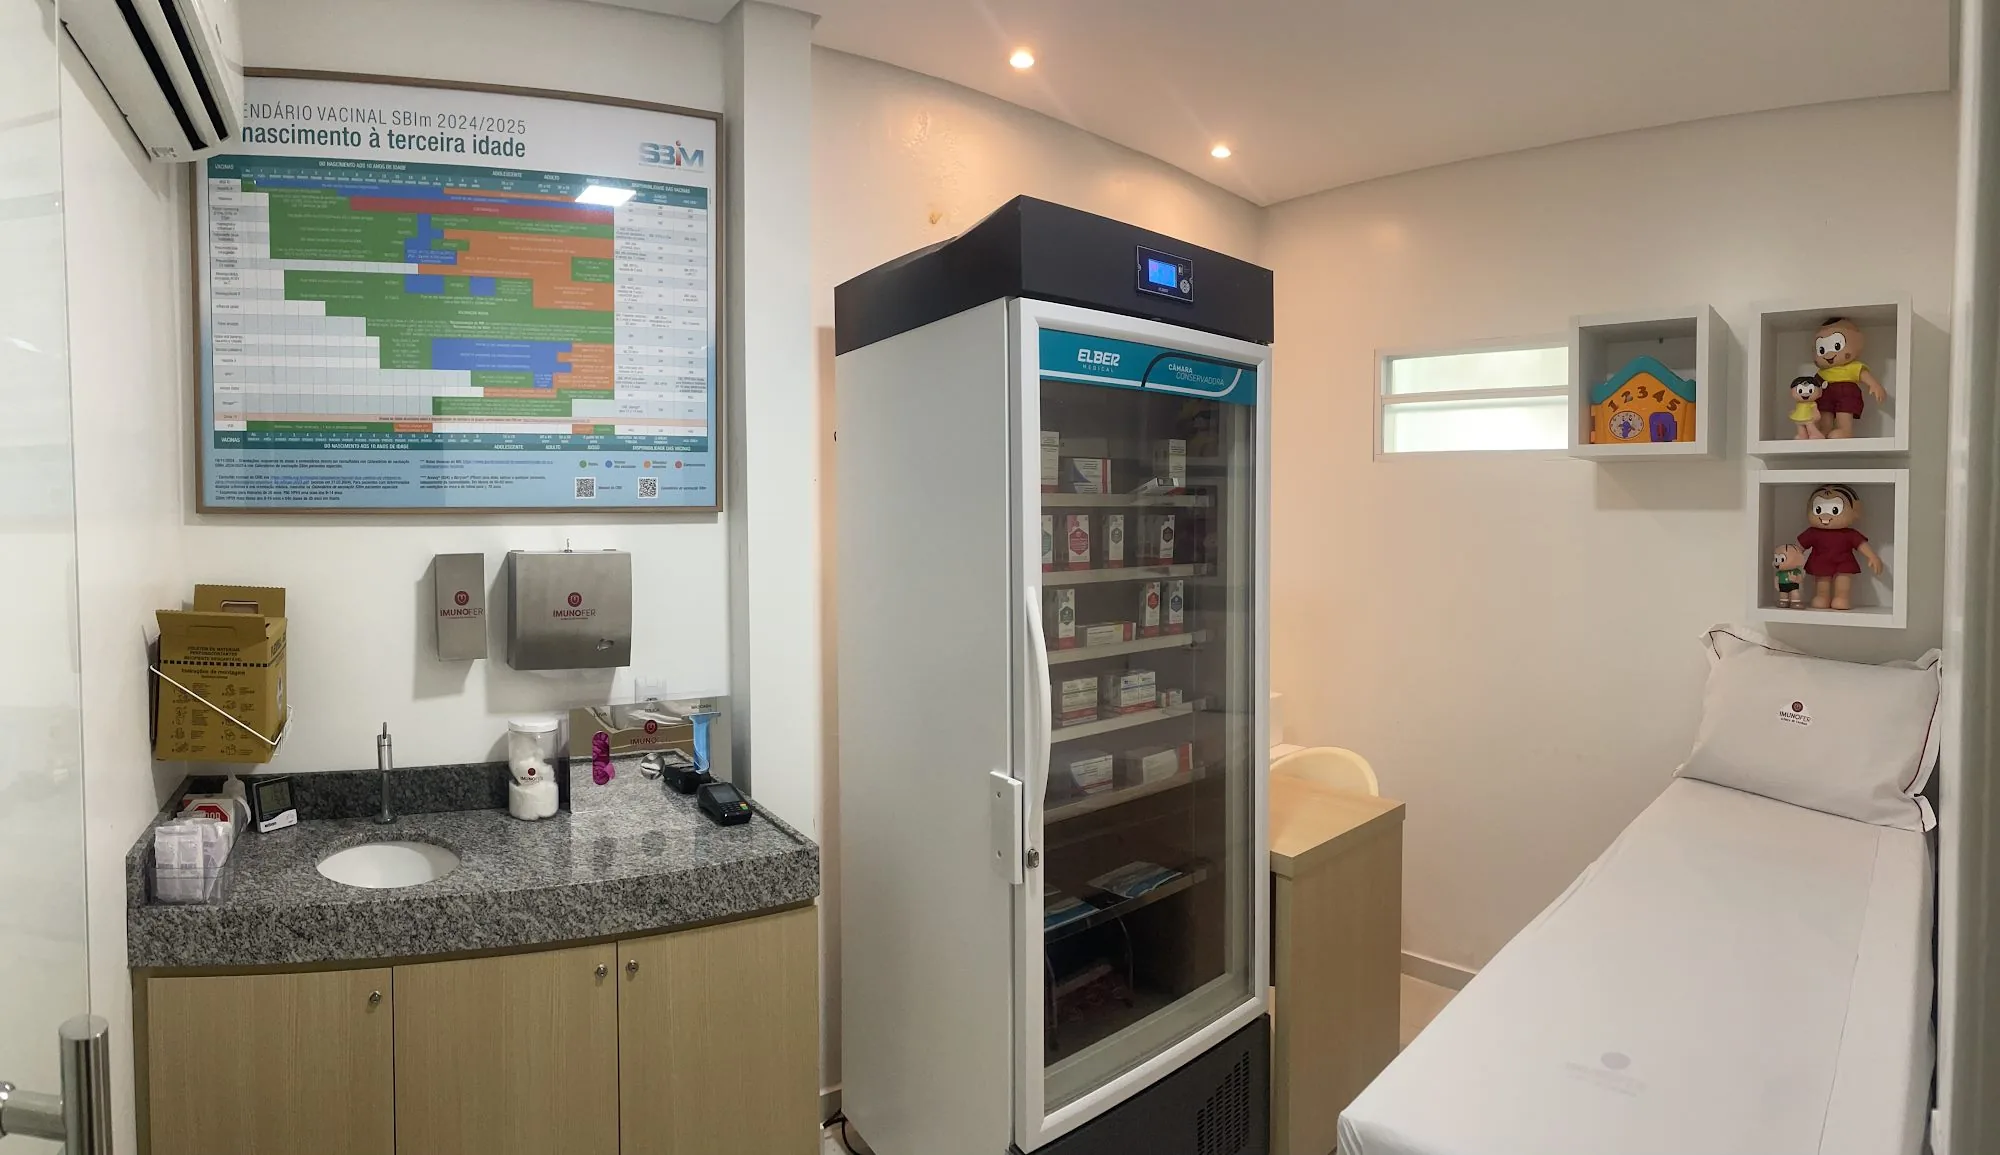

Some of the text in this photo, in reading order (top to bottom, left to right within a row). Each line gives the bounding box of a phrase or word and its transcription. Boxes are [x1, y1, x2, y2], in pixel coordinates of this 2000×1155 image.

[317, 106, 387, 125] VACINAL
[392, 110, 432, 127] SBIm
[437, 113, 526, 134] 2024/2025
[242, 124, 525, 158] nascimento à terceira idade
[1078, 348, 1120, 366] ELBER
[1082, 364, 1114, 373] MEDICAL
[1168, 362, 1193, 373] CÂMARA
[1176, 371, 1225, 386] CONSERVADORA
[1608, 386, 1680, 412] 1 2 3 4 5
[440, 607, 484, 617] IMUNOFER
[552, 608, 597, 618] IMUNOFER
[1779, 710, 1812, 722] IMUNOFER
